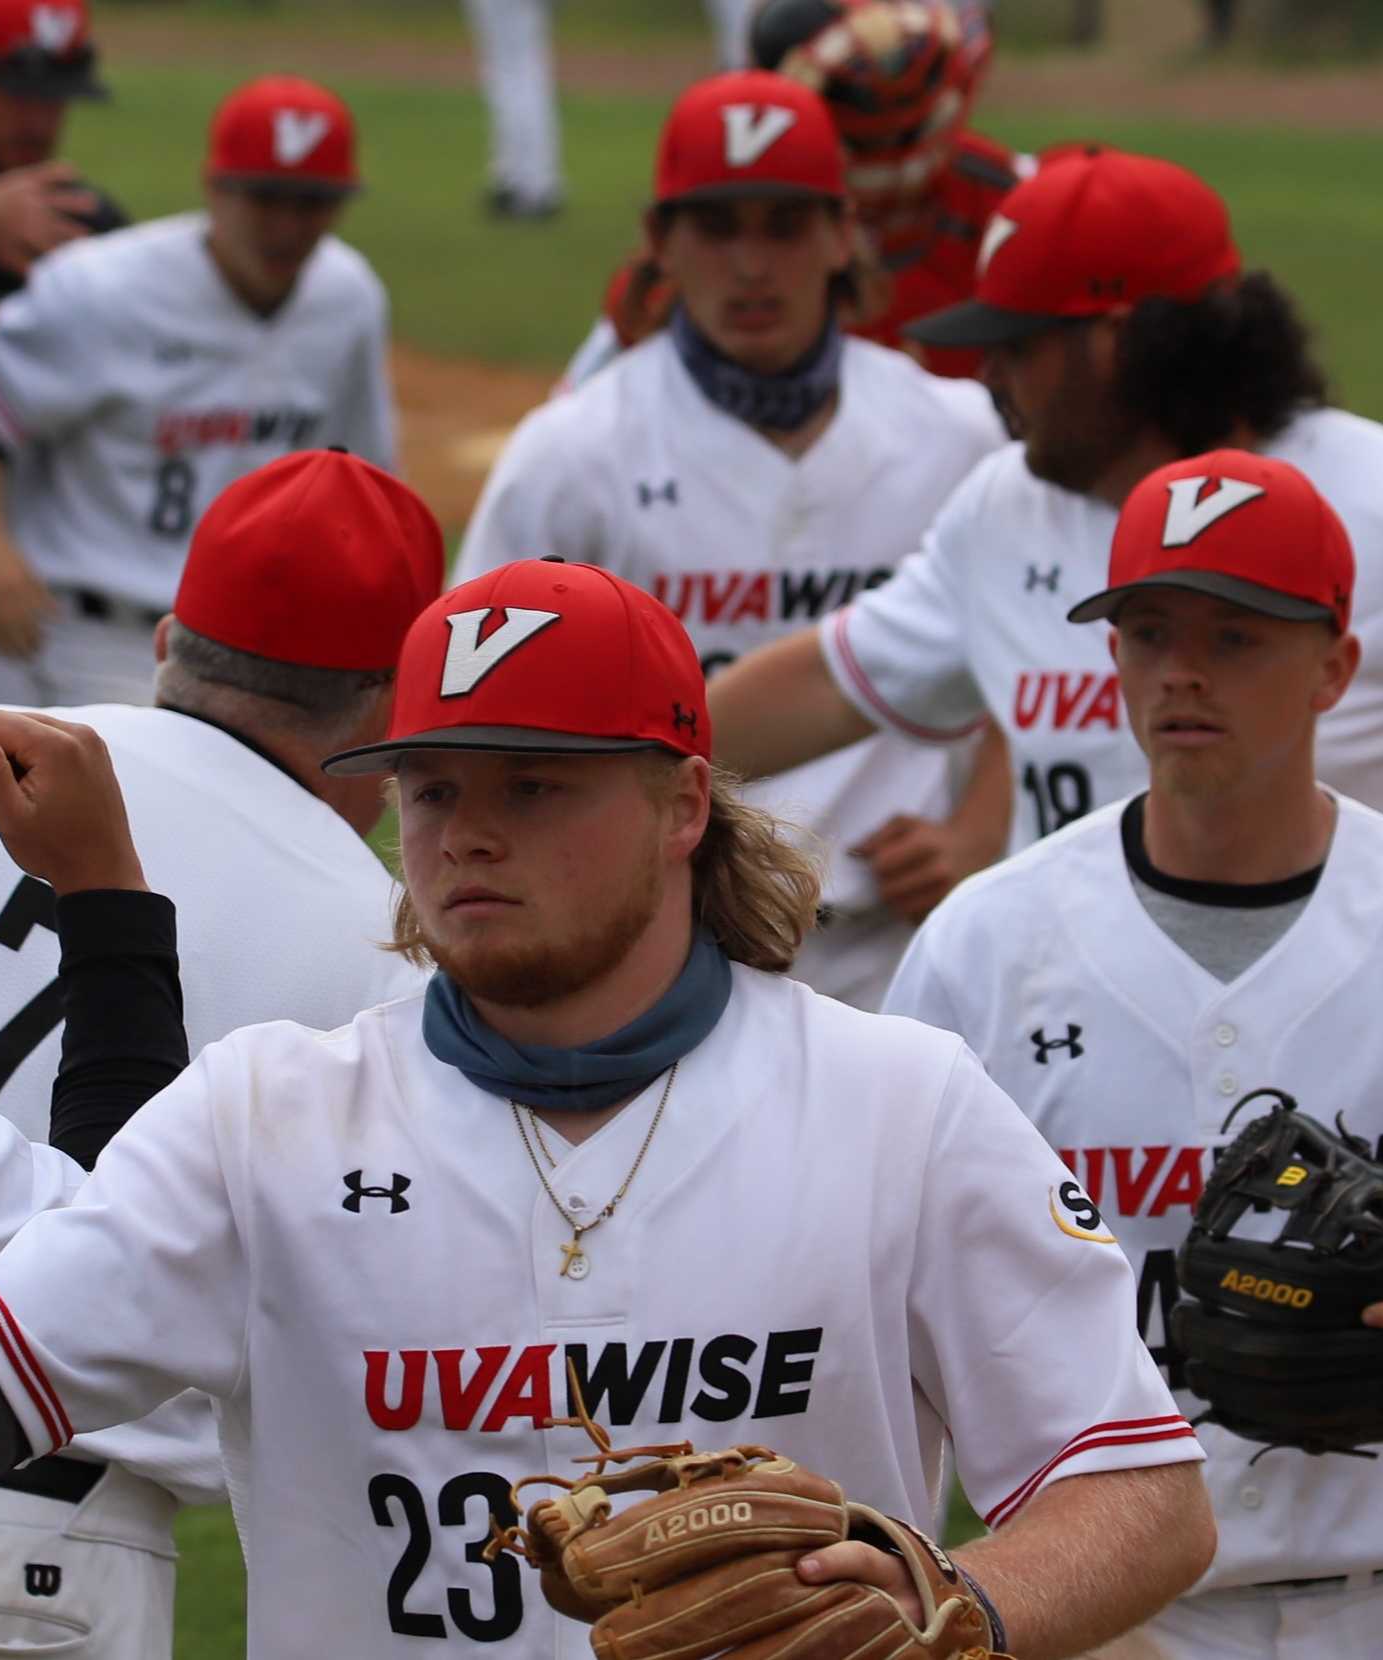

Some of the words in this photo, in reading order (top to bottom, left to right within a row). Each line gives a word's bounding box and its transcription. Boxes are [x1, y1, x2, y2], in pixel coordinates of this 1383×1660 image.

[272, 108, 330, 165] V
[721, 104, 798, 166] V
[150, 460, 197, 537] 8
[1162, 475, 1267, 549] V
[439, 606, 562, 698] V
[1220, 1268, 1314, 1308] A2000
[362, 1327, 823, 1432] UVAWISE
[367, 1472, 524, 1642] 23
[643, 1502, 752, 1551] A2000
